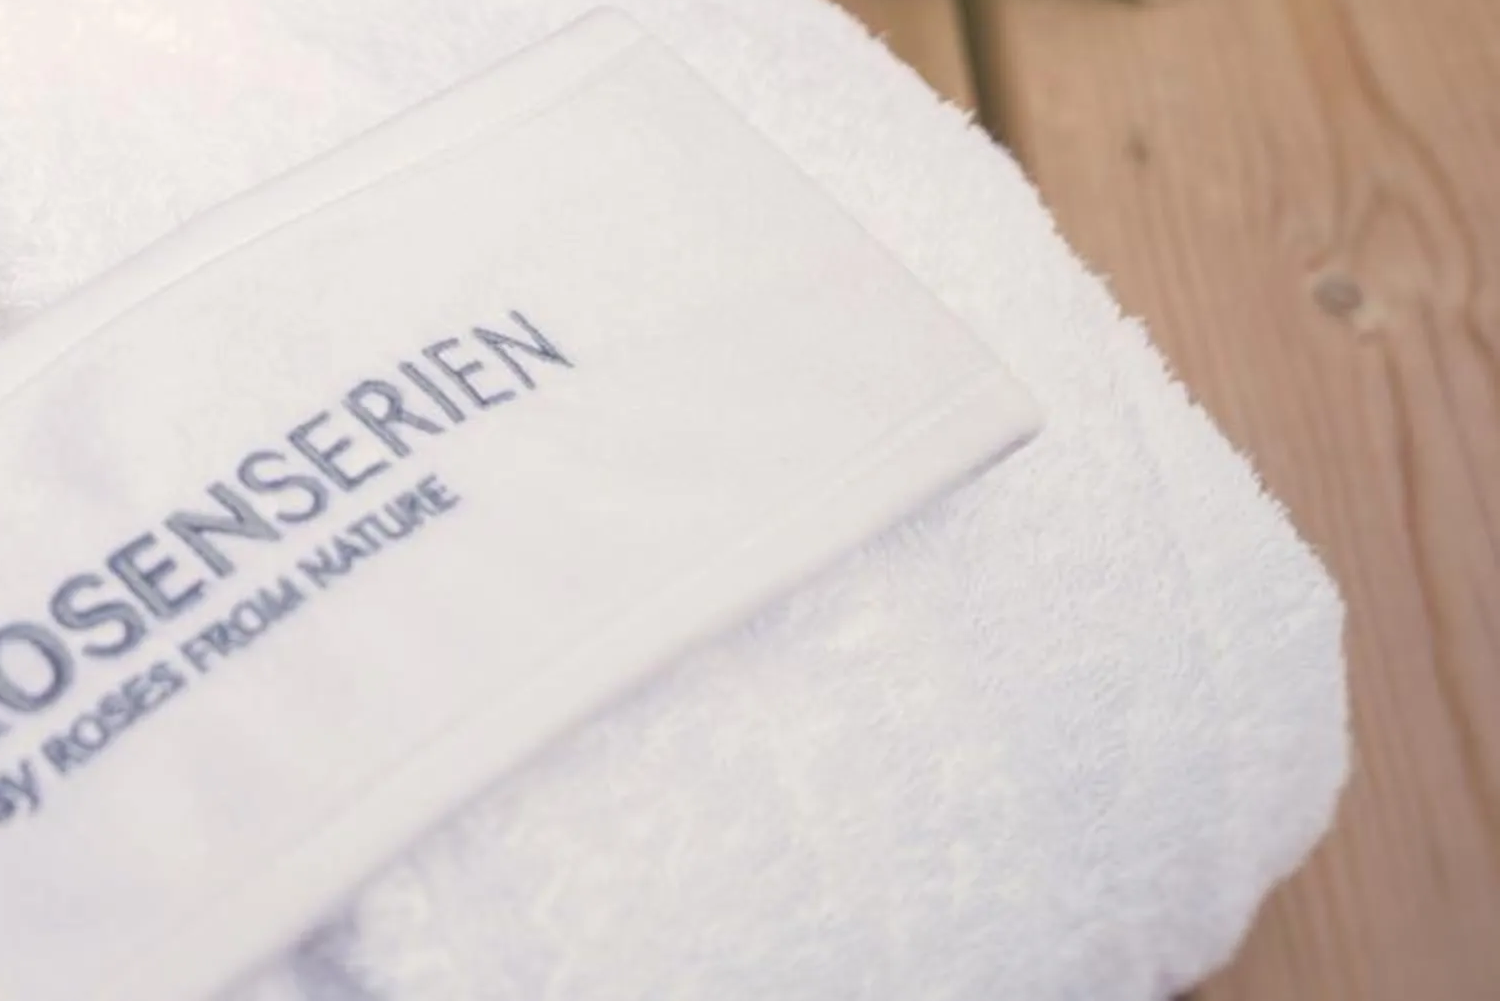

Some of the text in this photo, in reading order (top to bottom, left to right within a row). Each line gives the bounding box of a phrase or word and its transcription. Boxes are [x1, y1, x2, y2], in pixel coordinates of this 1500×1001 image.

[41, 661, 187, 774] ROSES
[180, 576, 308, 673] FROM
[298, 473, 461, 589] NATURE
